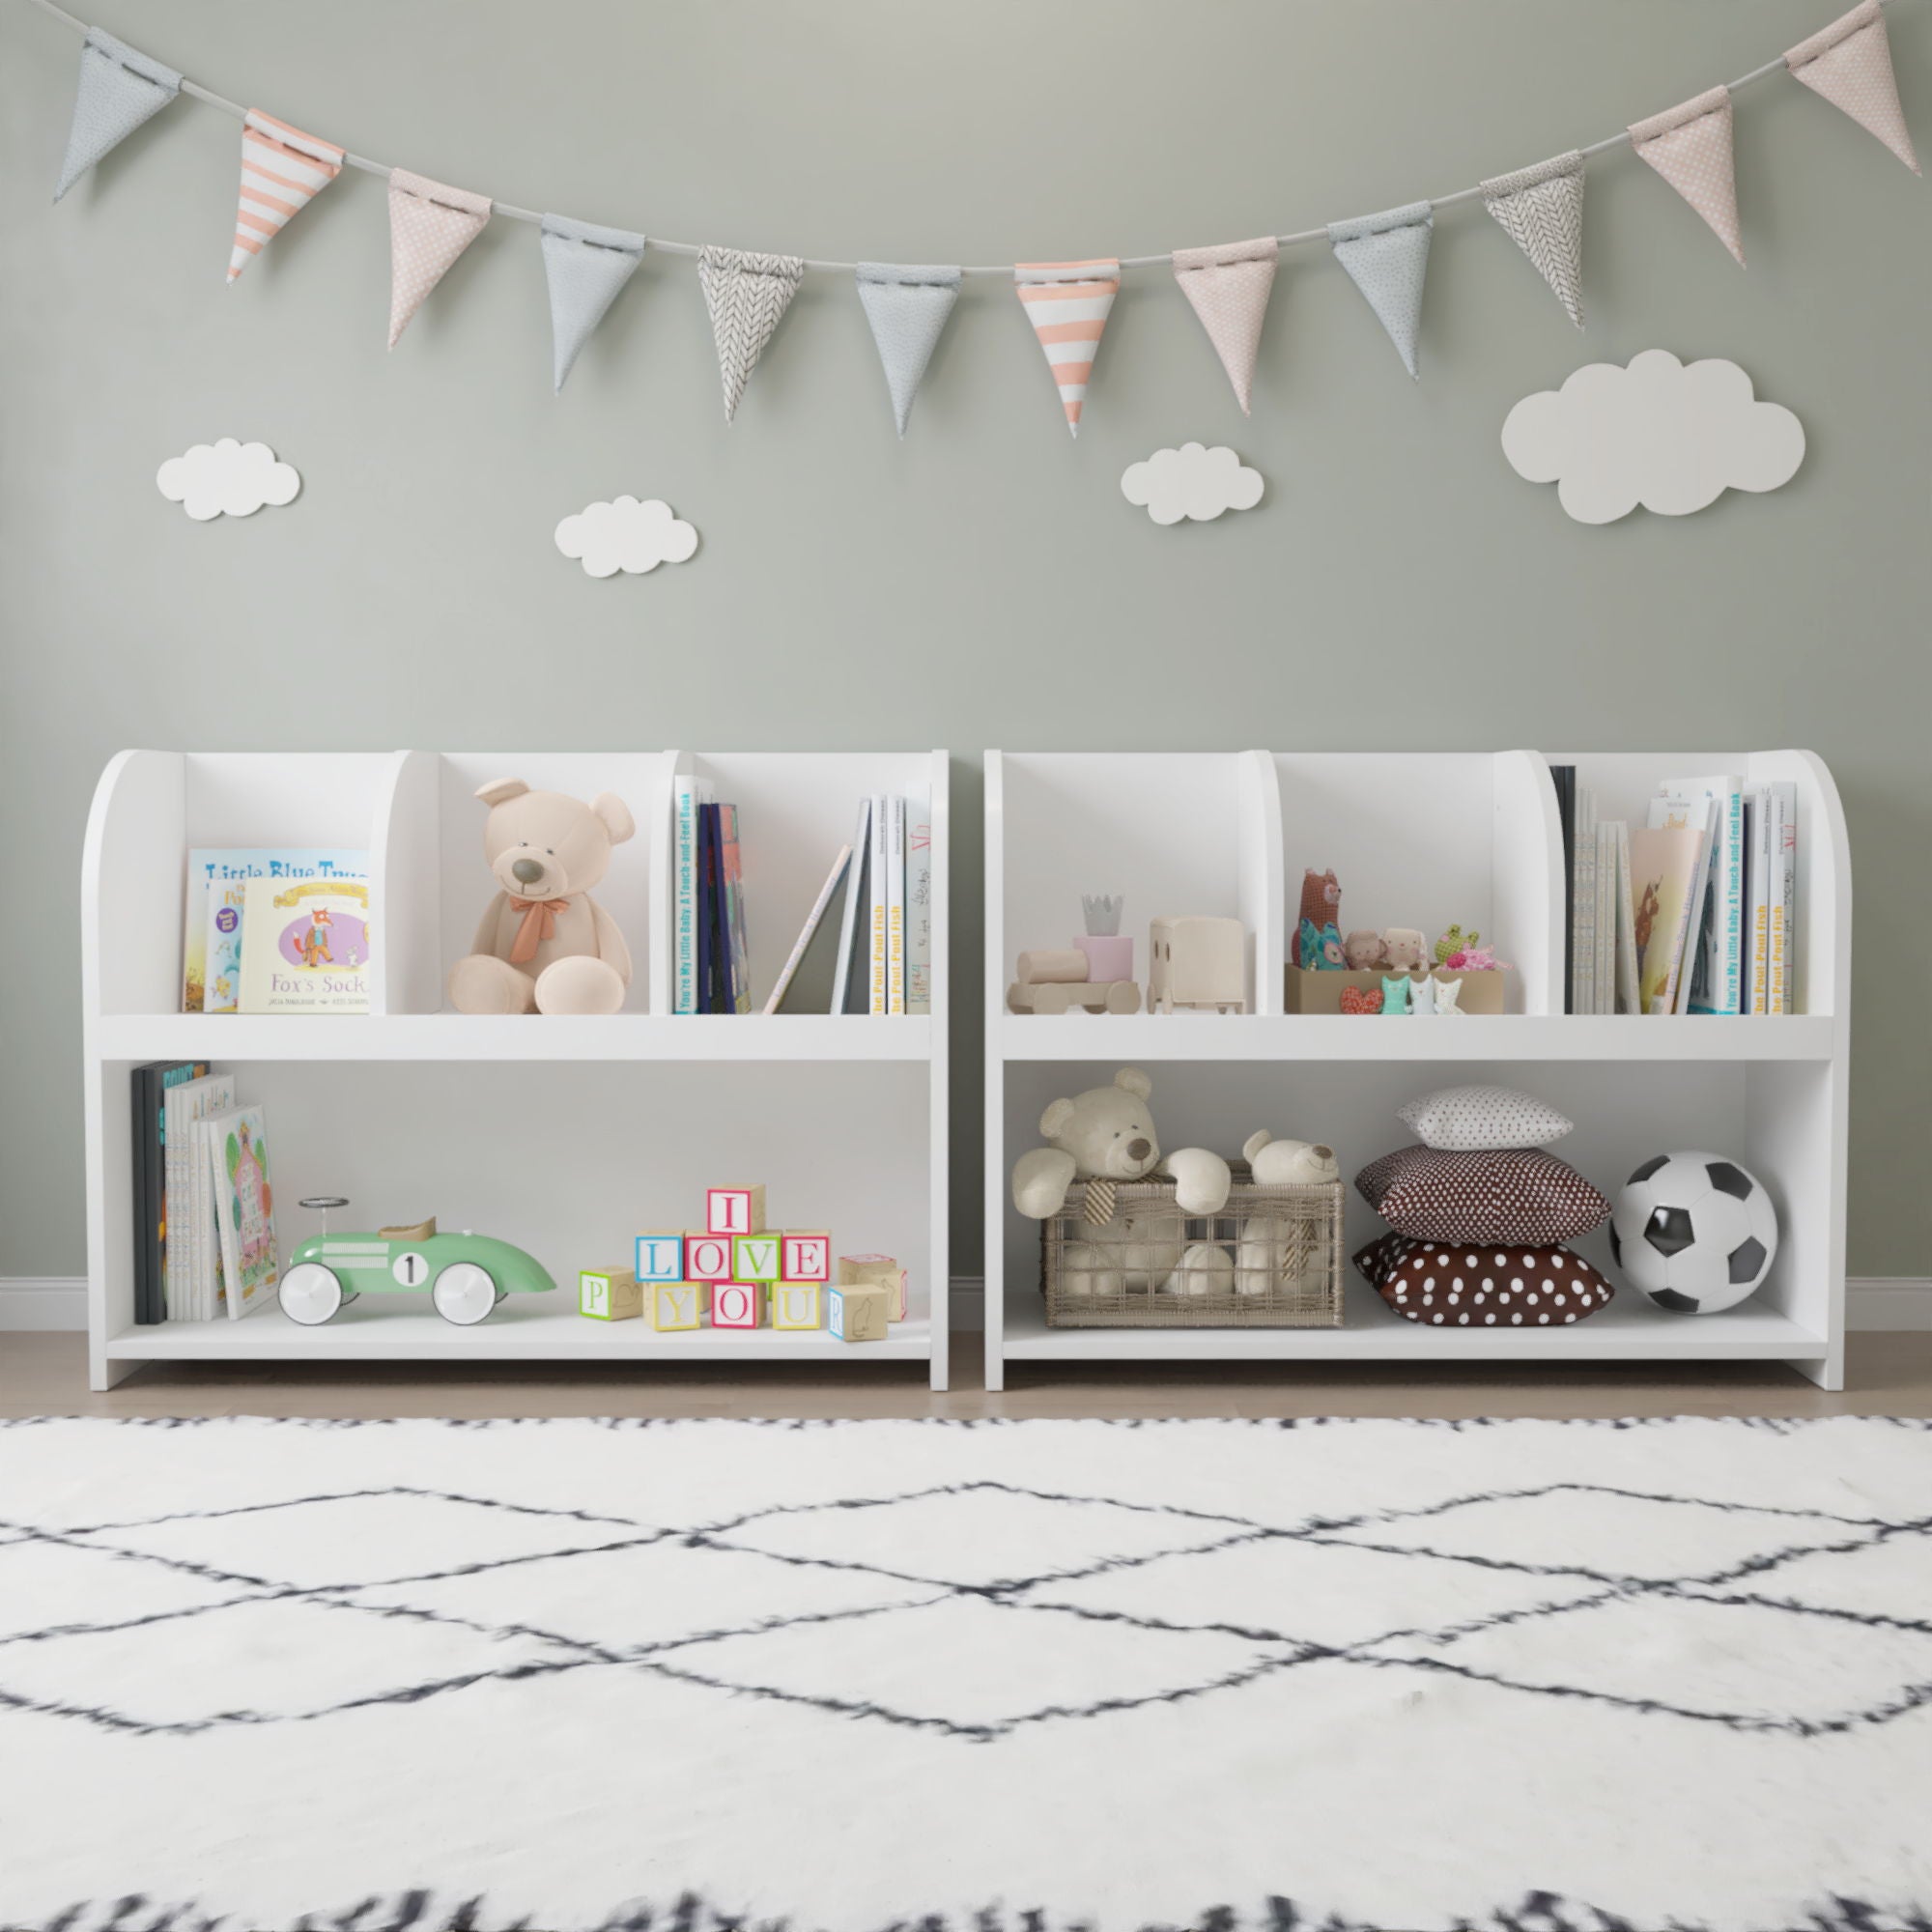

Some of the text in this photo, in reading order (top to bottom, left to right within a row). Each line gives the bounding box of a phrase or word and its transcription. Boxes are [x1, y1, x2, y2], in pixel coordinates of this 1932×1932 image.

[679, 793, 691, 817] Book
[1729, 793, 1741, 817] Book
[679, 820, 691, 895] Touch-and-Feel
[1728, 820, 1740, 895] Touch-and-Feel
[874, 905, 884, 930] Fish
[891, 905, 901, 930] Fish
[1756, 905, 1768, 930] Fish
[1773, 905, 1783, 931] Fish
[679, 936, 691, 959] Little
[1727, 936, 1738, 959] Little
[679, 962, 692, 976] My
[873, 934, 884, 993] Pout-Pout
[891, 934, 901, 993] Pout-Pout
[1726, 962, 1739, 976] My
[1754, 934, 1767, 993] Pout-Pout
[1772, 934, 1783, 994] Pout-Pout
[271, 973, 314, 993] Fox's
[679, 979, 691, 1009] You're
[1726, 979, 1739, 1009] You're
[723, 1197, 736, 1229] I
[405, 1256, 414, 1284] 1
[646, 1242, 820, 1275] LOVE
[588, 1280, 604, 1309] P
[664, 1288, 811, 1323] YOU
[832, 1297, 843, 1332] R
